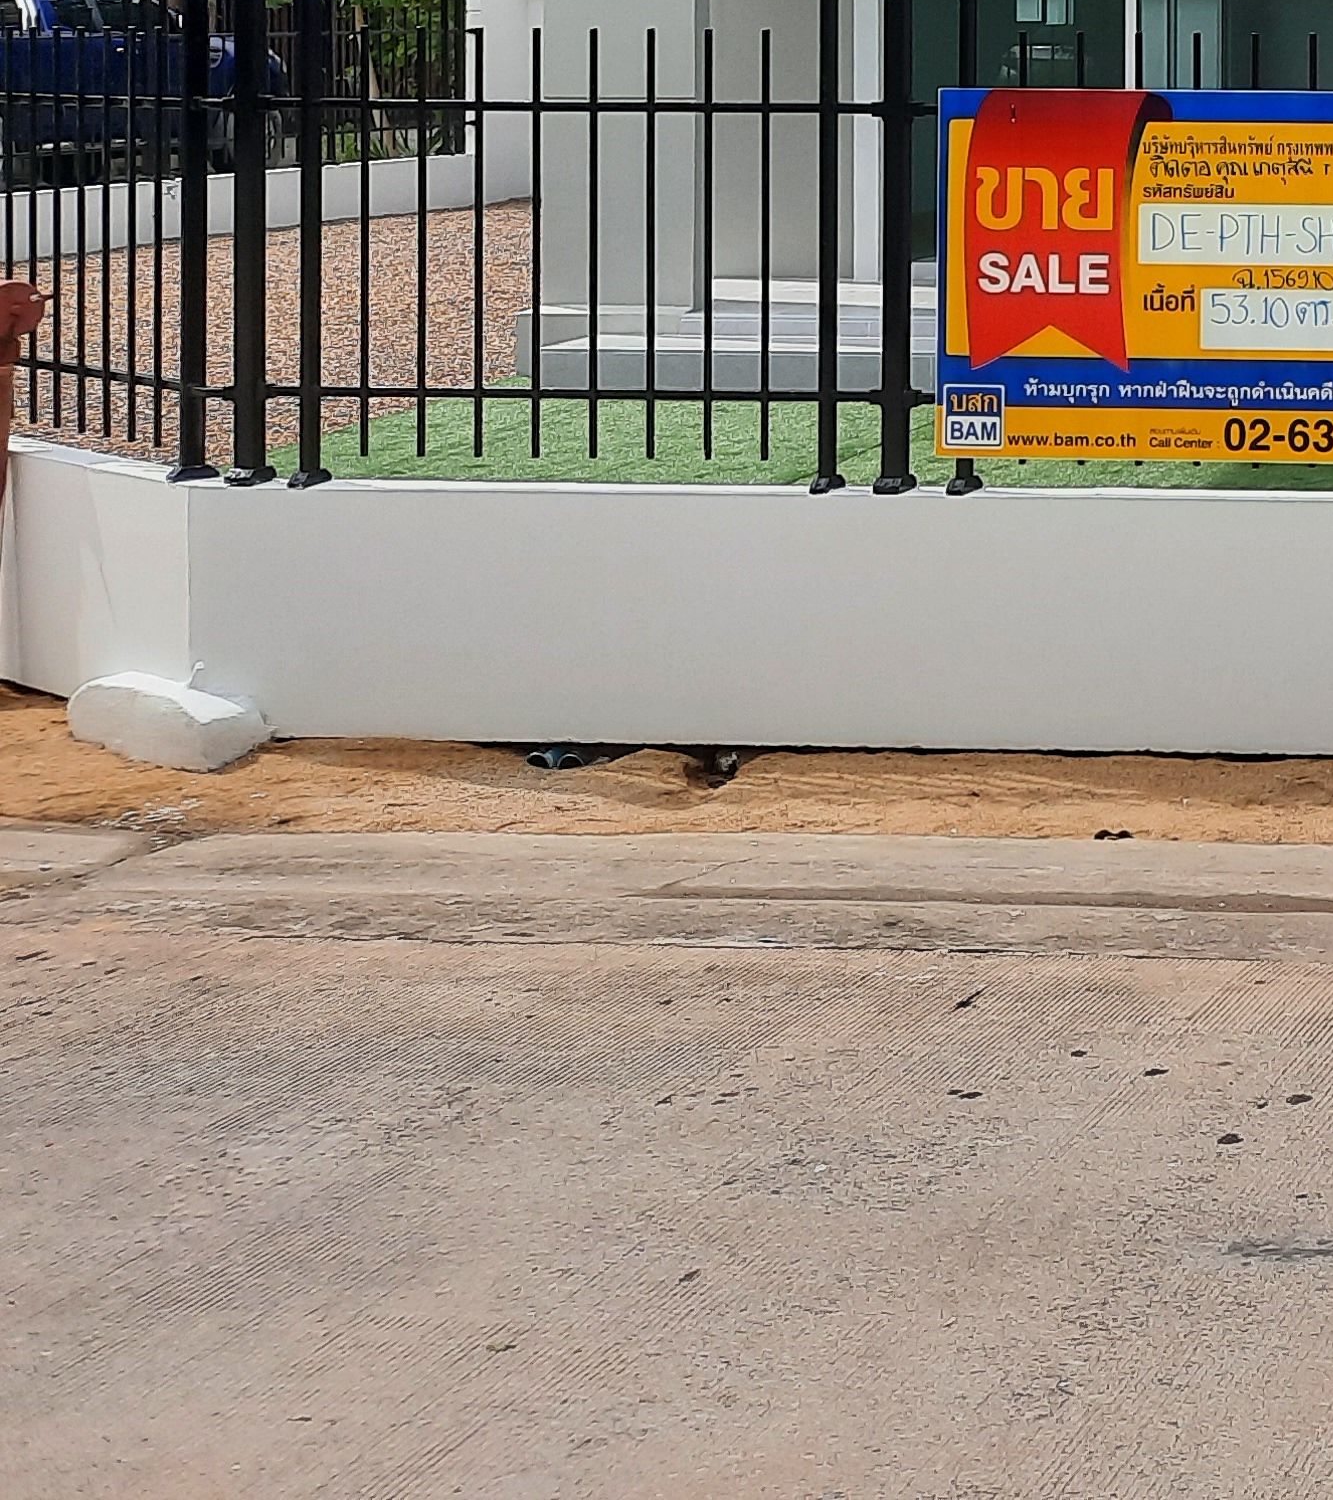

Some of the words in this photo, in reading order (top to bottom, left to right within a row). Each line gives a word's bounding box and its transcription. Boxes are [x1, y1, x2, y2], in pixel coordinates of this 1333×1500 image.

[975, 166, 1114, 231] ขาย
[1143, 183, 1235, 199] รหัสทรัพย์สิน
[977, 252, 1110, 294] SALE
[1142, 283, 1196, 313] เนื้อที่
[1023, 377, 1111, 404] ห้ามบุกรุก
[950, 393, 998, 413] บสก
[950, 421, 998, 441] BAM
[1007, 432, 1137, 448] www.bam.co.th
[1149, 436, 1172, 449] Call
